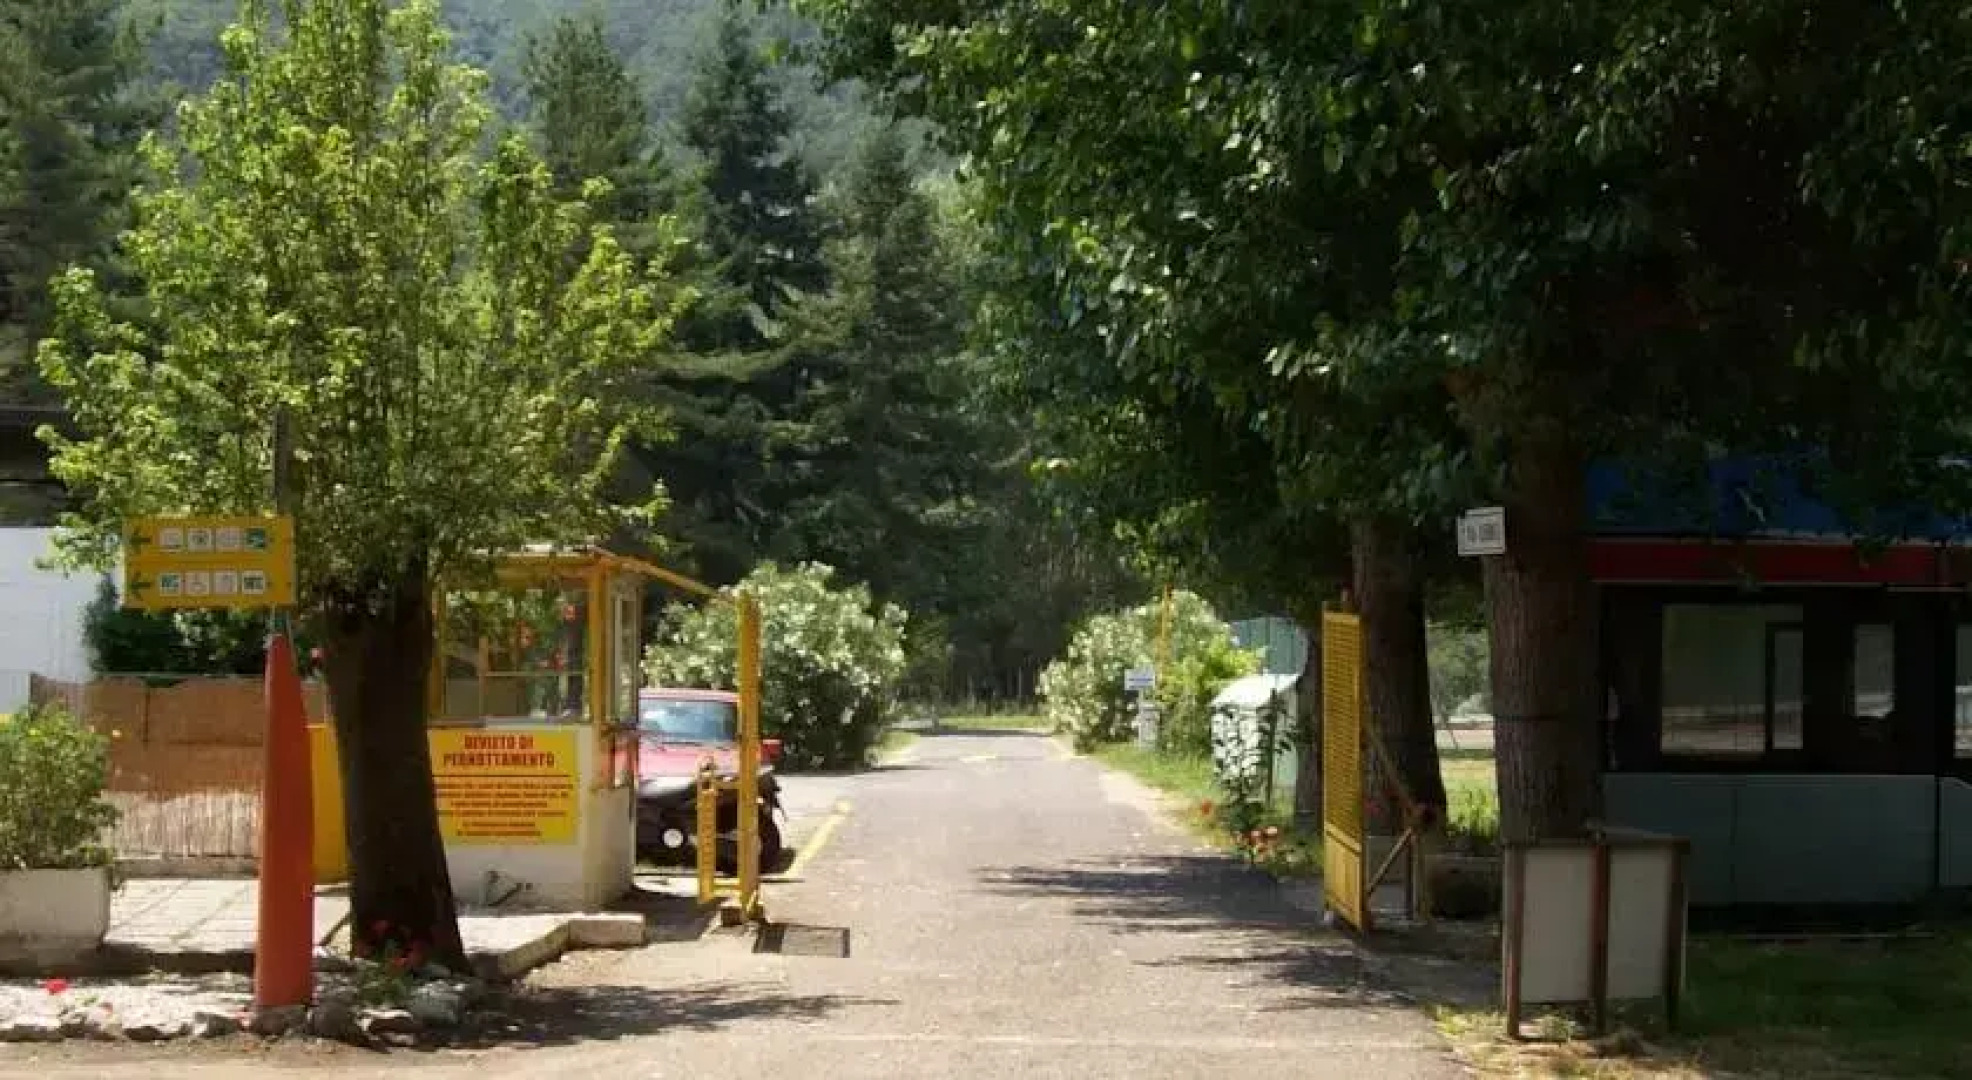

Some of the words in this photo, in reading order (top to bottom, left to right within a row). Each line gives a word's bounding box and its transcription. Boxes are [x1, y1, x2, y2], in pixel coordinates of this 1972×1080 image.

[464, 734, 515, 750] DIVIETO
[519, 734, 534, 750] DI
[443, 752, 555, 768] PERNOTTAMENTO
